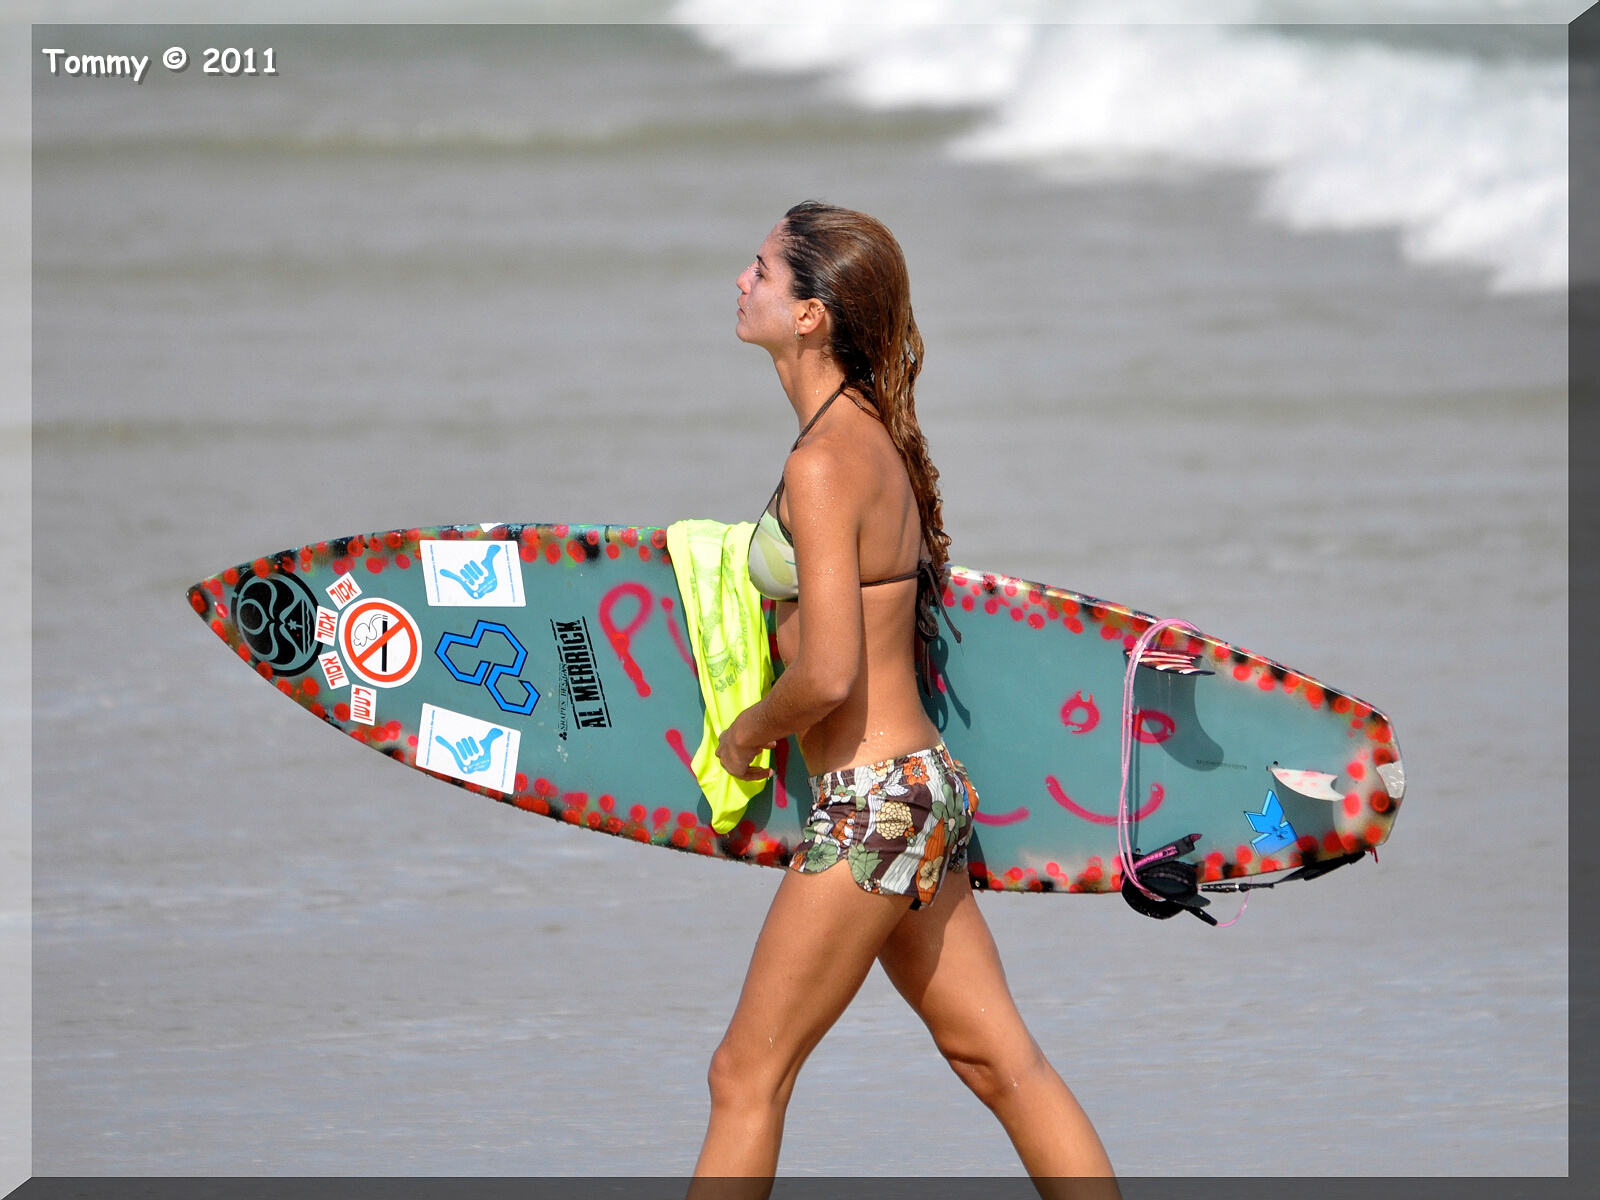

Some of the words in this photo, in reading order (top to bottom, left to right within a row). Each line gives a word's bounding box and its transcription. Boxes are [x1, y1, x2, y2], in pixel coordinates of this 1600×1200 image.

[329, 578, 358, 605] אסור
[316, 611, 336, 639] אסור
[321, 655, 344, 687] אסור
[556, 619, 600, 702] MERRICK
[353, 687, 373, 722] לעשן
[578, 707, 607, 728] AL
